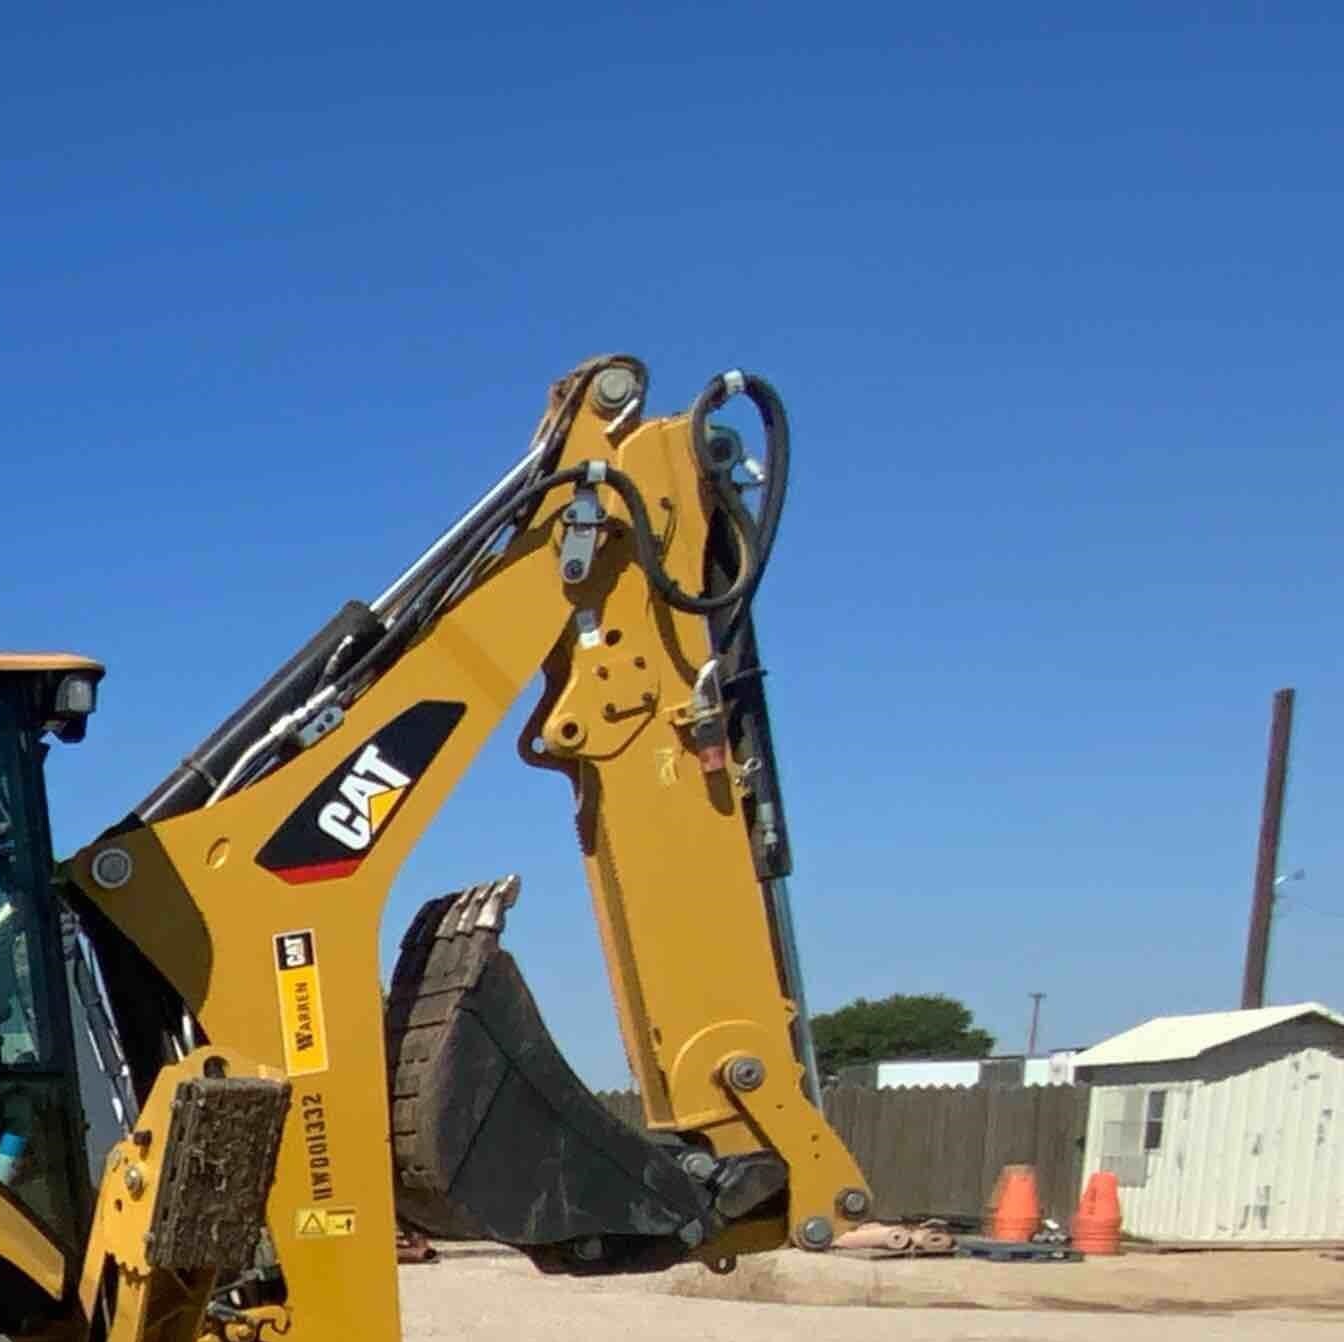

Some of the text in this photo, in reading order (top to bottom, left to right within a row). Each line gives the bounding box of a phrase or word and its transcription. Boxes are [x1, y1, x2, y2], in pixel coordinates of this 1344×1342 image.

[317, 744, 411, 850] CAT
[283, 936, 315, 1052] WARREN CAT
